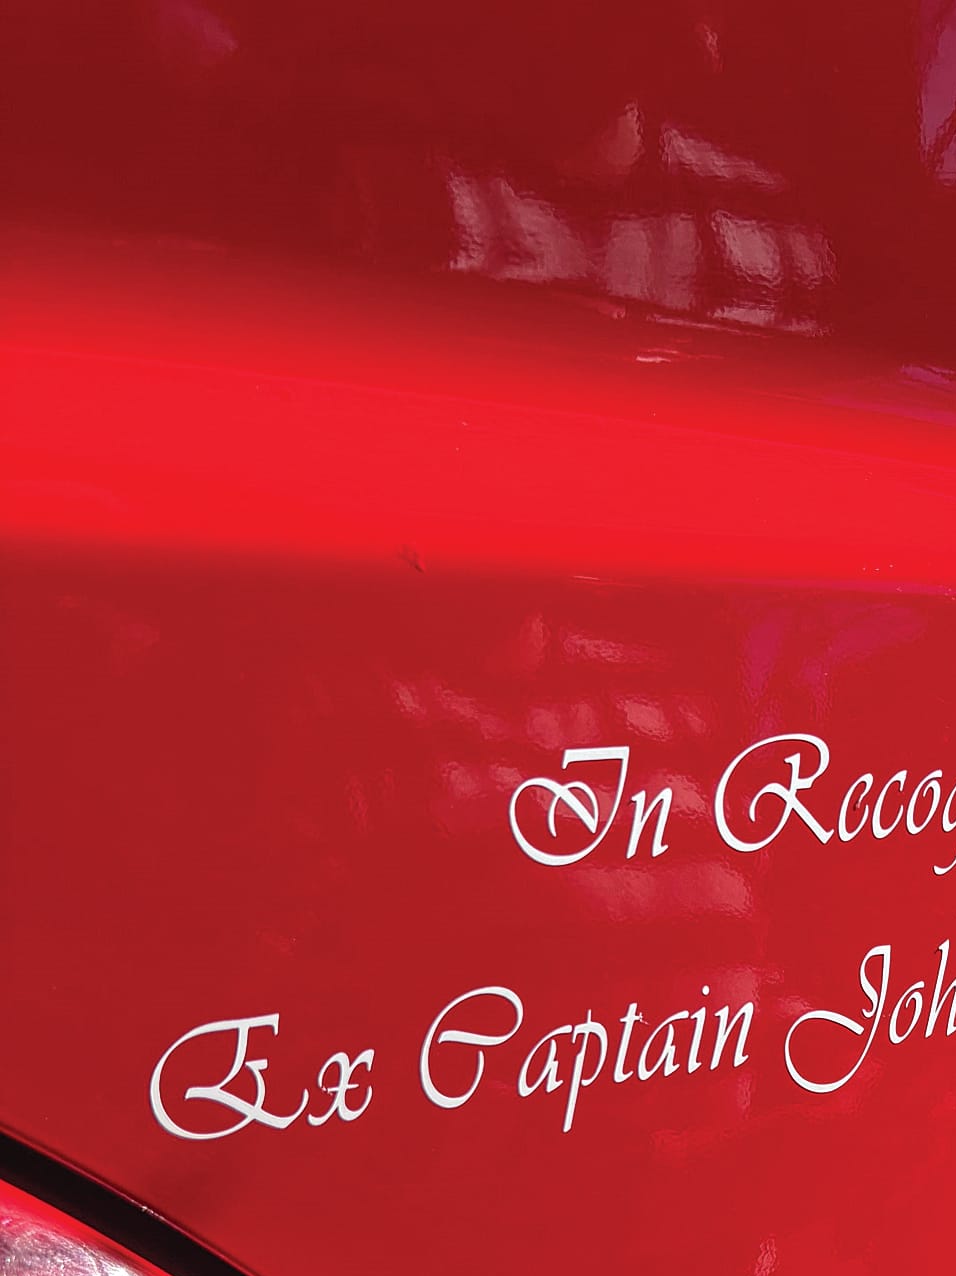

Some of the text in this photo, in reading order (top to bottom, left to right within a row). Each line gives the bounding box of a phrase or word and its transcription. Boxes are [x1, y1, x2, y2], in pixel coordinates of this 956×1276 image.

[509, 746, 672, 866] In
[150, 1013, 374, 1140] Ex
[420, 985, 754, 1132] Captain
